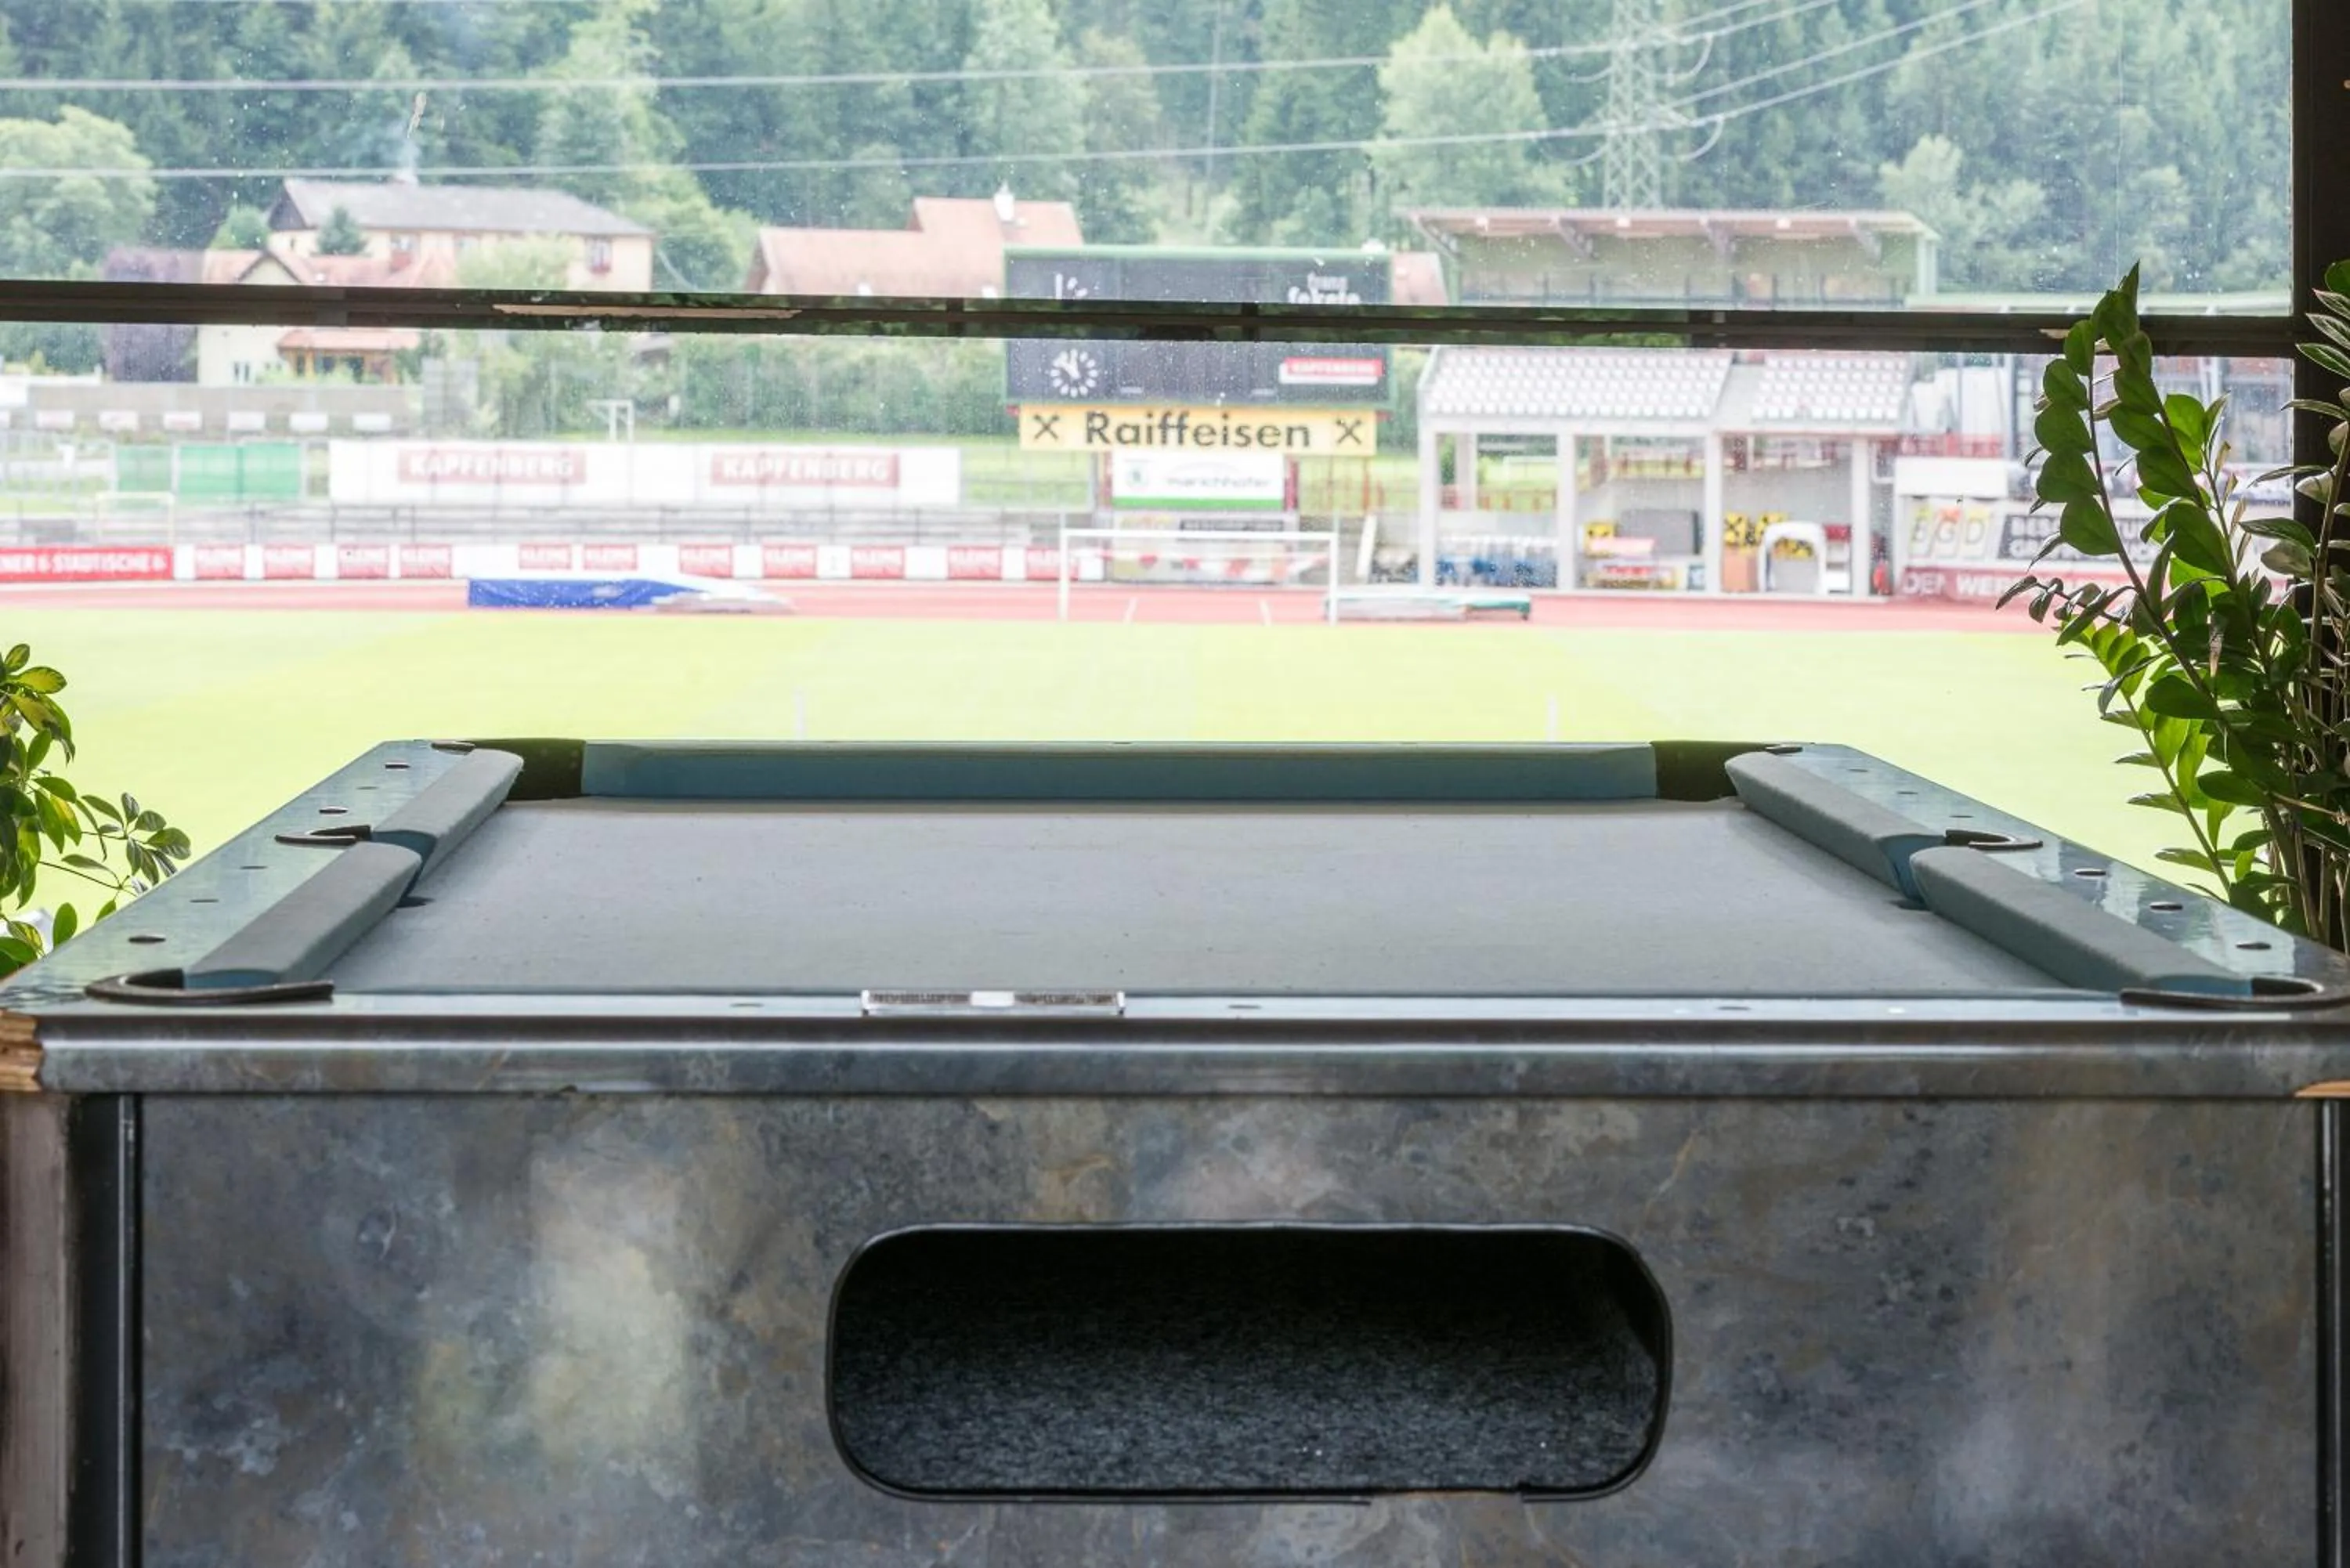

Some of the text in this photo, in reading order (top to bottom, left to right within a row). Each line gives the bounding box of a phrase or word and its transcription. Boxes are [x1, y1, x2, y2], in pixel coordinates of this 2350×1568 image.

[1086, 410, 1310, 447] Raiffeisen
[409, 453, 575, 477] KAPFENBERG
[724, 457, 888, 479] KAPFENBERG
